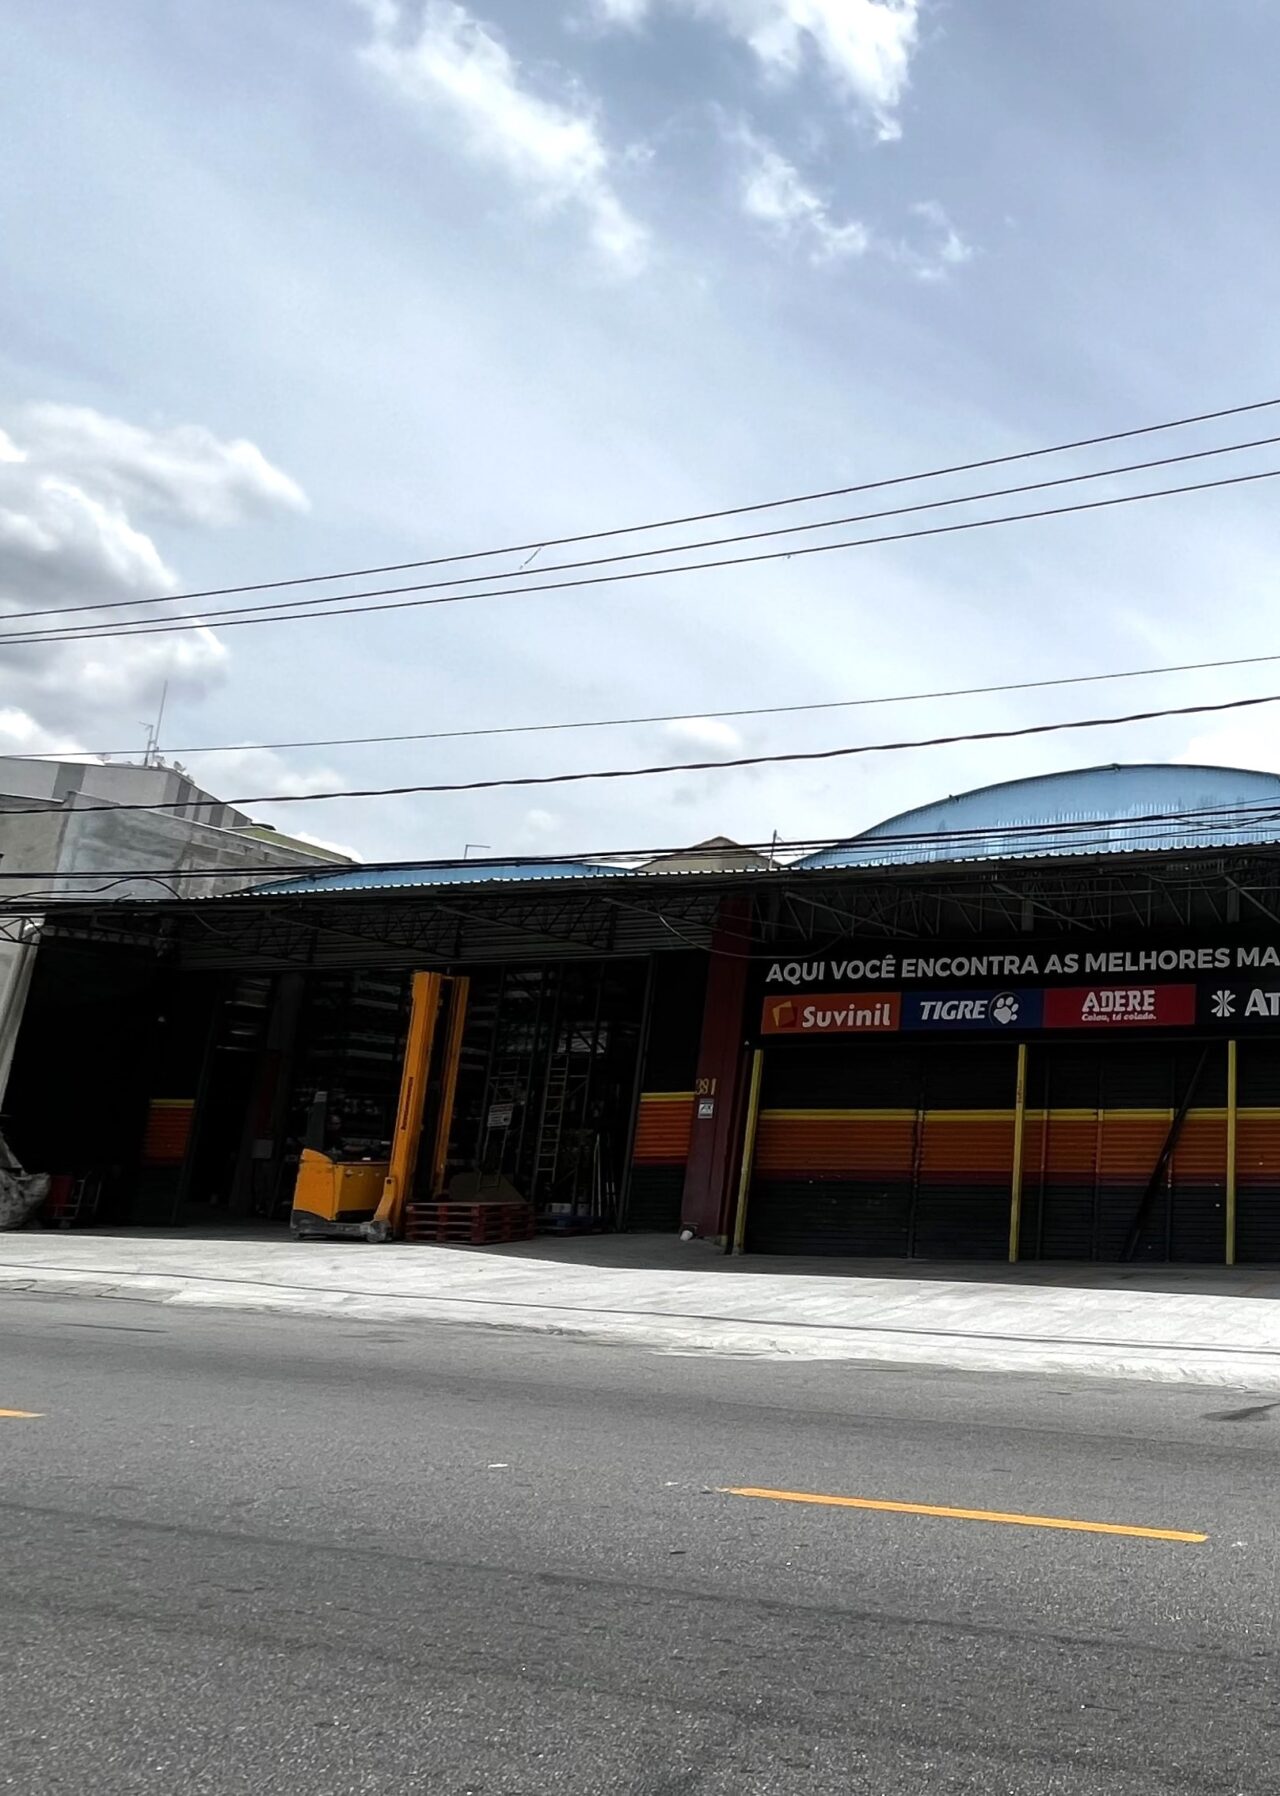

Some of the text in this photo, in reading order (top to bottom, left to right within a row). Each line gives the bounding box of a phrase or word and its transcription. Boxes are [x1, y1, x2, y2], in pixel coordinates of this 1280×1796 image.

[765, 961, 826, 986] AQUI
[830, 954, 897, 980] VOCÊ
[901, 954, 1040, 979] ENCONTRA
[1044, 953, 1079, 975] AS
[1084, 948, 1231, 973] MELHORES
[919, 999, 990, 1021] TIGRE
[1081, 989, 1156, 1012] ADERE
[801, 1003, 891, 1028] Suvinil
